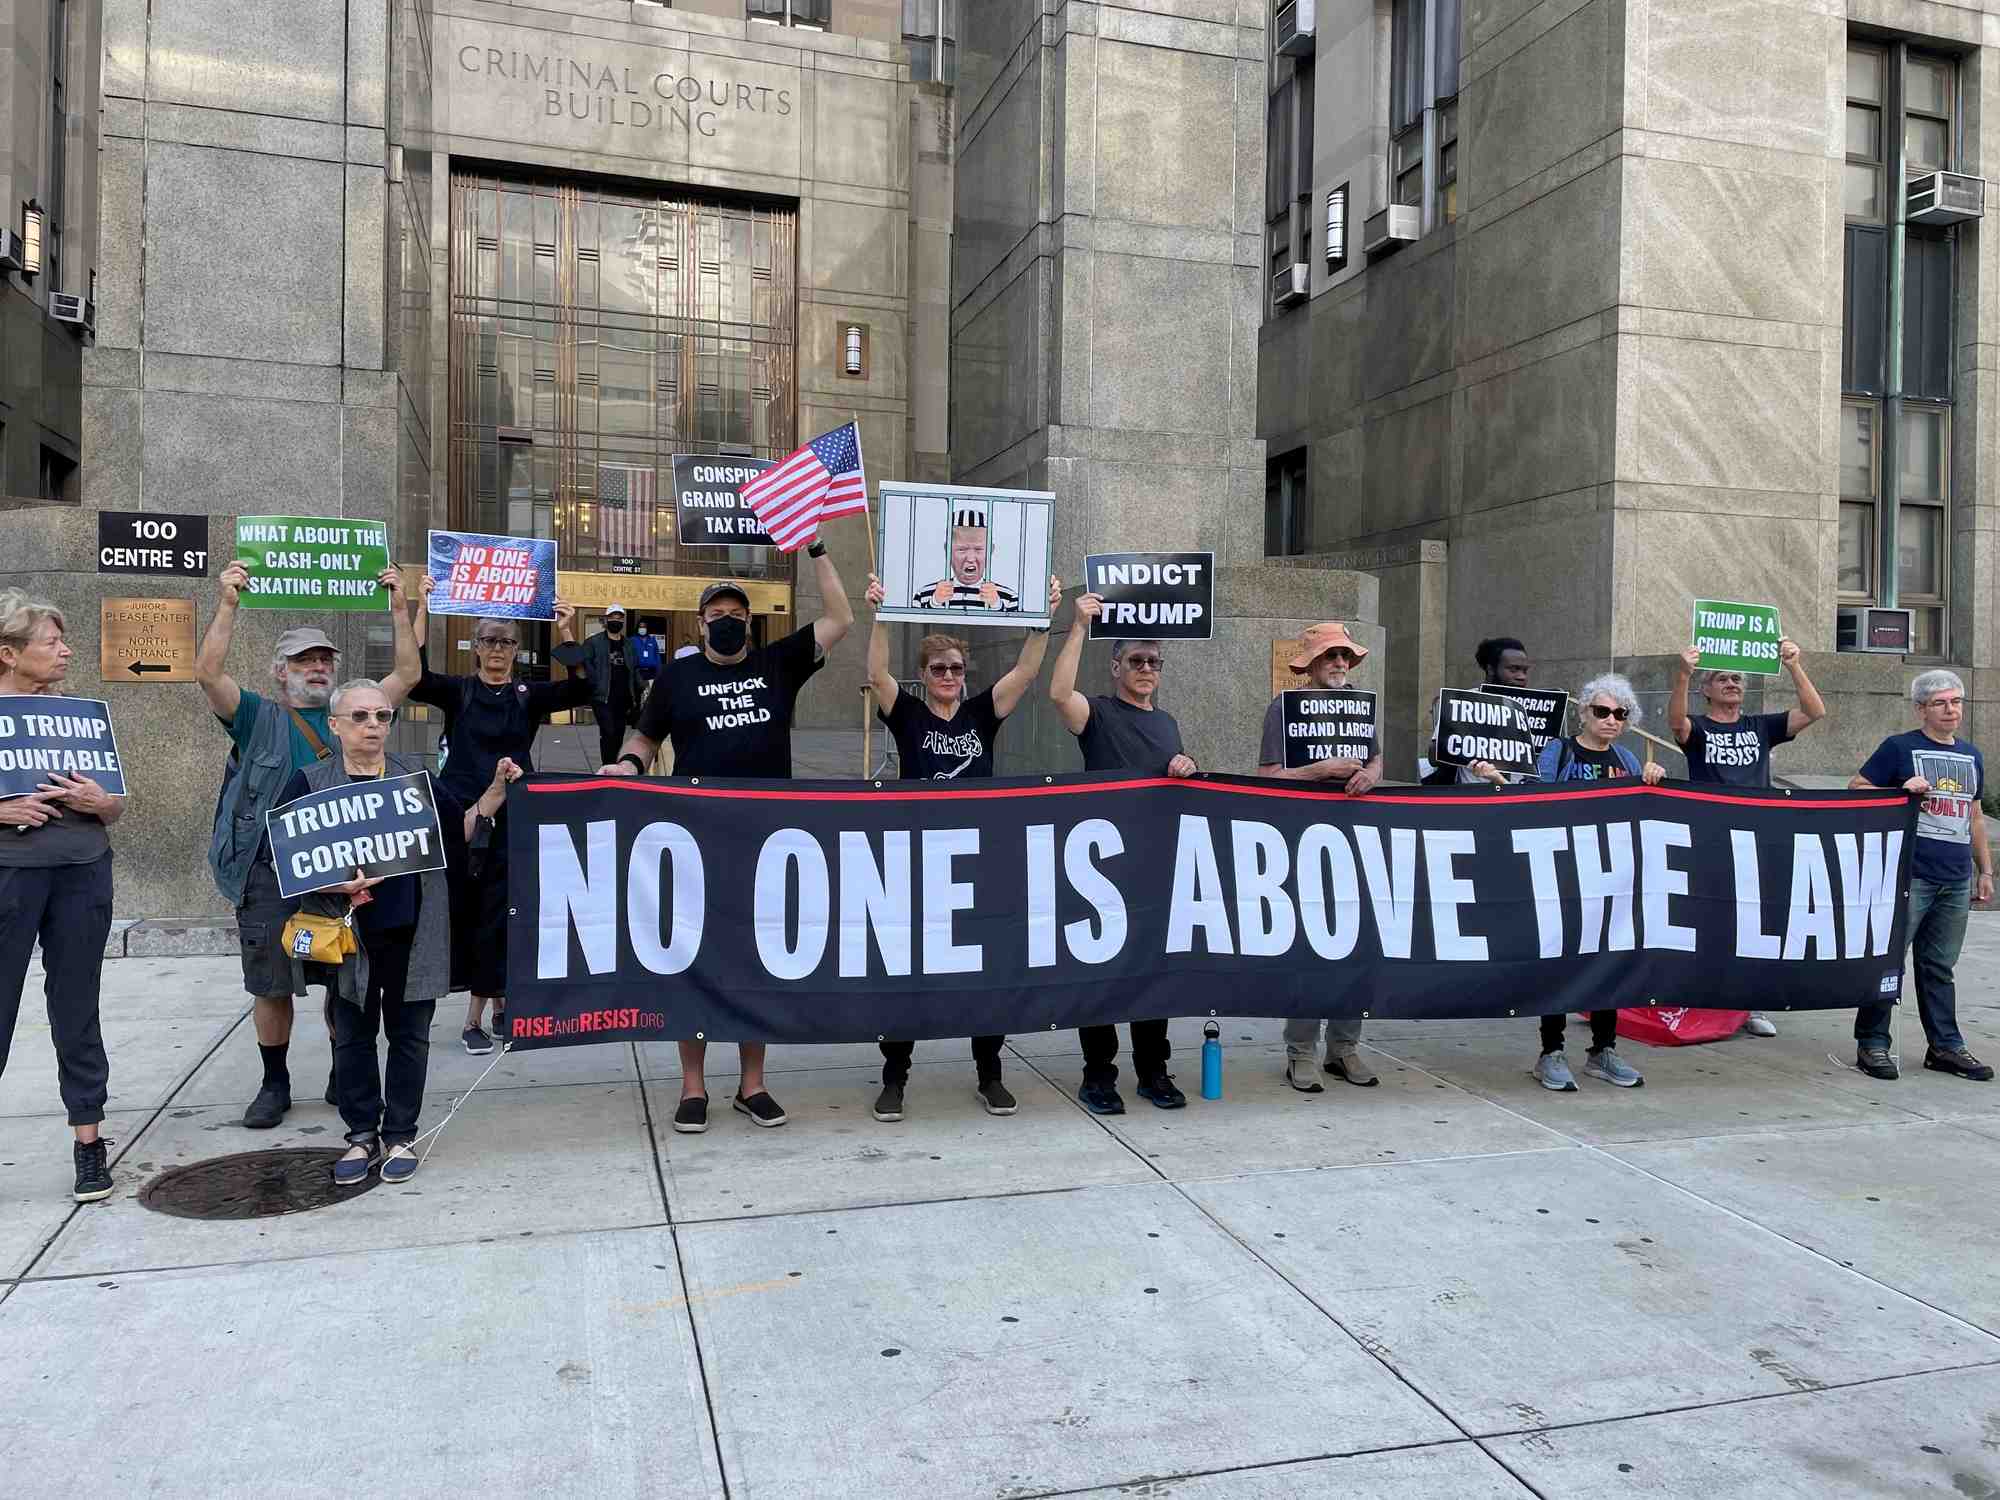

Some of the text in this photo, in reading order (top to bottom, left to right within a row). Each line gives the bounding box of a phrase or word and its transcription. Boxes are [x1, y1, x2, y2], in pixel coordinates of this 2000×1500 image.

[458, 46, 791, 116] CRIMINAL COURTS
[545, 89, 717, 136] BUILDING
[694, 466, 763, 484] CONSPIR
[682, 491, 735, 508] GRAND
[132, 520, 177, 540] 100
[240, 525, 385, 546] WHAT ABOUT THE
[704, 516, 769, 535] TAX FRA
[101, 548, 207, 569] CENTRE ST
[265, 551, 361, 571] CASH-ONLY
[459, 547, 529, 567] NO ONE
[450, 564, 537, 585] IS ABOVE
[1097, 564, 1202, 585] INDICT
[250, 576, 377, 596] SKATING RINK?
[455, 582, 535, 603] THE LAW
[105, 612, 191, 623] PLEASE ENTER
[1100, 603, 1203, 624] TRUMP
[1699, 611, 1775, 634] TRUMP IS A
[142, 625, 154, 634] AT
[129, 637, 168, 646] NORTH
[1697, 636, 1778, 660] CRIME BOSS
[119, 648, 179, 658] ENTRANCE
[698, 677, 768, 696] UNFUCK
[718, 694, 755, 710] THE
[1300, 699, 1371, 715] CONSPIRACY
[1510, 696, 1556, 712] OCRACY
[706, 708, 771, 730] WORLD
[1449, 699, 1512, 727] TRUMP
[1513, 709, 1528, 732] IS
[22, 714, 107, 739] TRUMP
[1288, 722, 1335, 738] GRAND
[0, 749, 118, 771] OUNTABLE
[1307, 744, 1369, 760] TAX FRAUD
[1447, 734, 1533, 765] CORRUPT
[1705, 743, 1760, 767] RESIST
[280, 787, 424, 838] TRUMP IS
[291, 827, 430, 879] CORRUPT
[537, 813, 1905, 981] NO ONE IS ABOVE THE LAW
